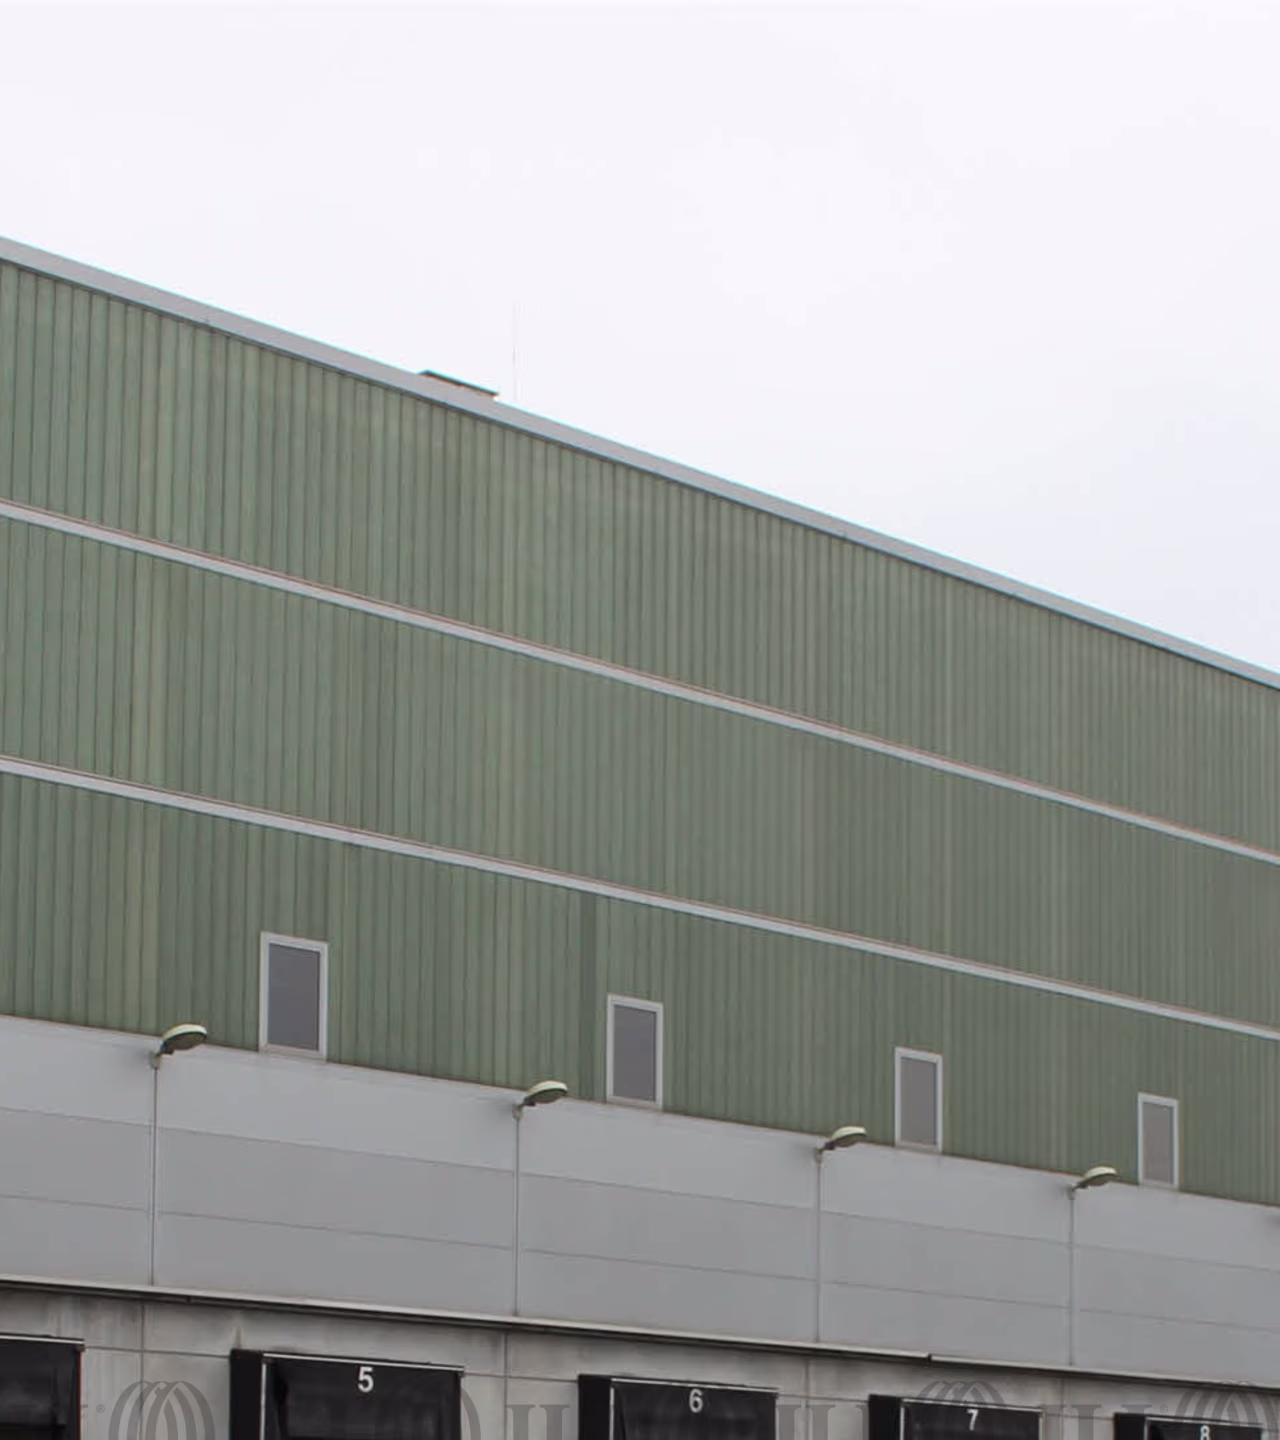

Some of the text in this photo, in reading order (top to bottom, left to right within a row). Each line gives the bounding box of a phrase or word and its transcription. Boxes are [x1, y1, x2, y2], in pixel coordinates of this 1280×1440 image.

[357, 1366, 374, 1393] 5
[689, 1388, 704, 1413] 6
[967, 1408, 979, 1431] 7
